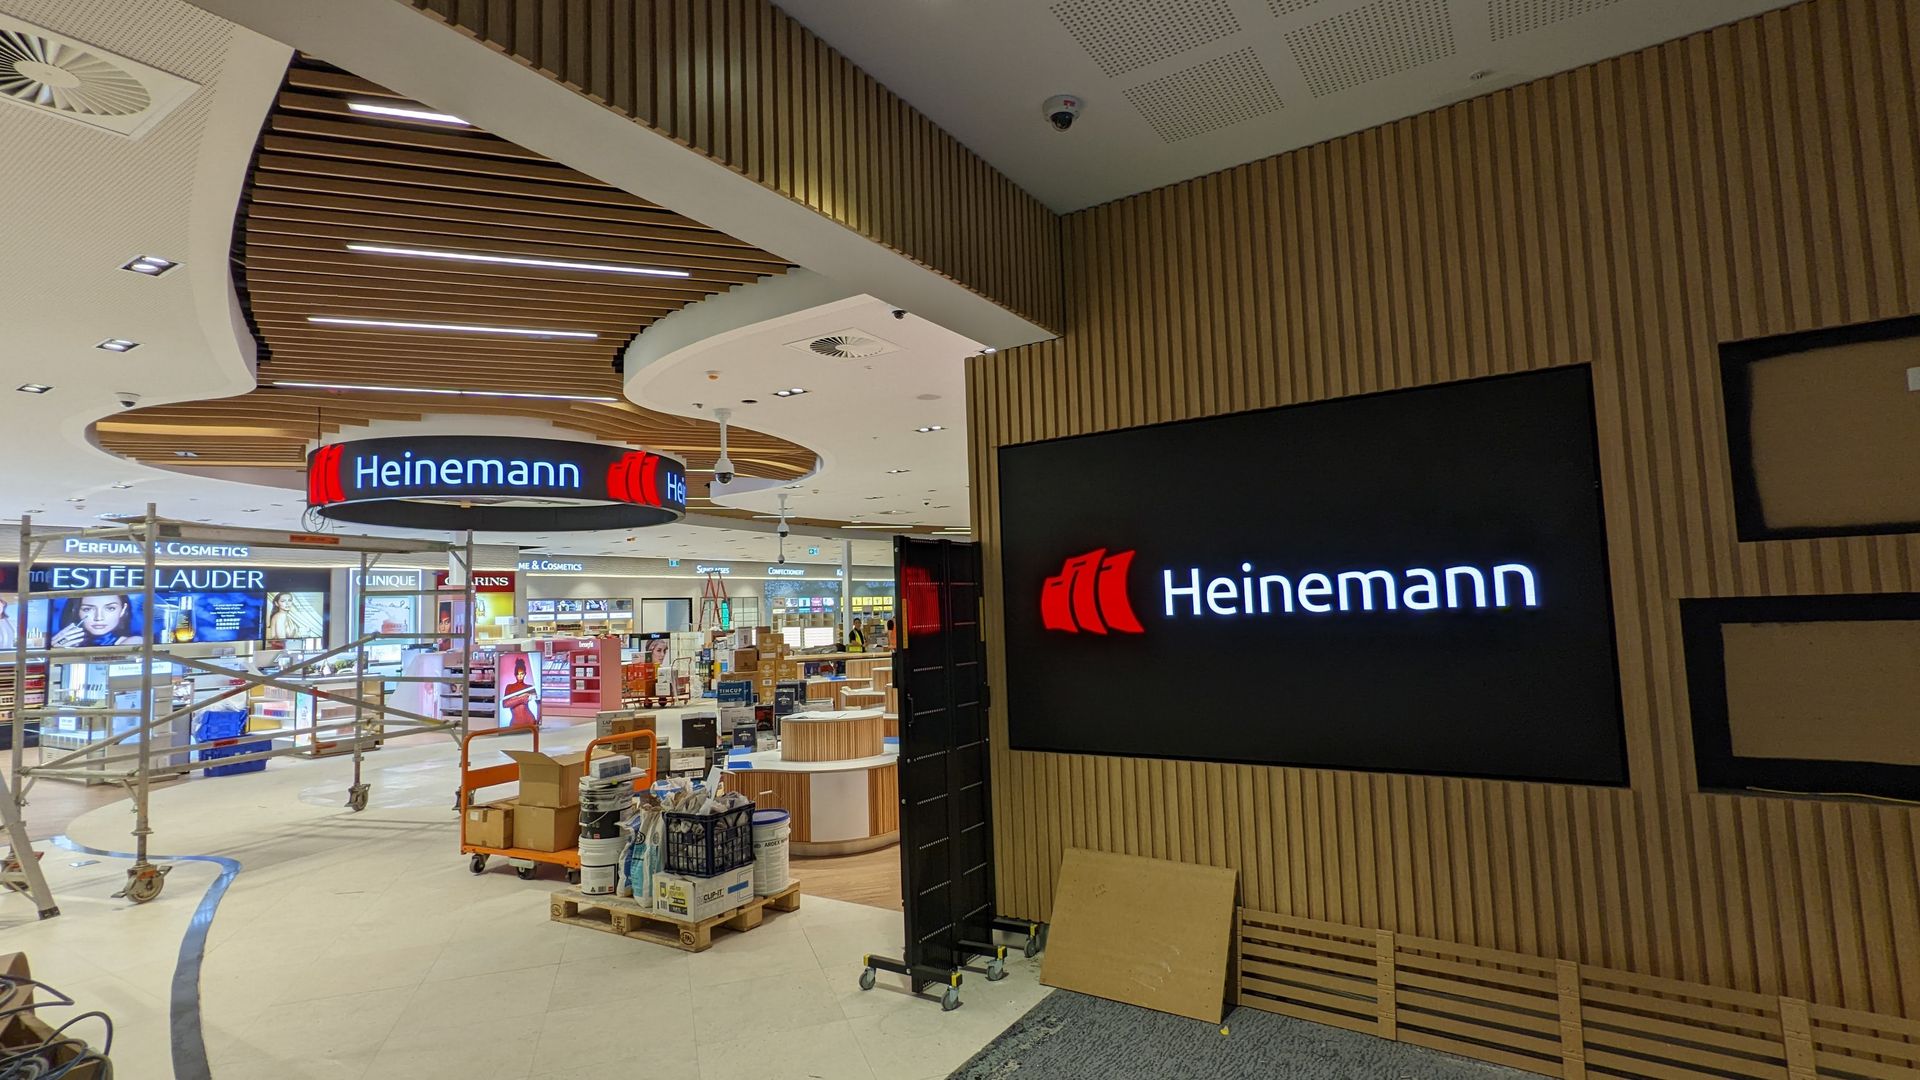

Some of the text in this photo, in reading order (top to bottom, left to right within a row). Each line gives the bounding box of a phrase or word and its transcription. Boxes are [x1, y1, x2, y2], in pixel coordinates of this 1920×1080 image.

[356, 452, 579, 489] Heinemann
[166, 542, 249, 557] COSMETICS
[532, 560, 540, 570] &
[541, 560, 583, 571] COSMETICS
[154, 569, 264, 589] LAUDER
[444, 576, 509, 587] CRINS
[1163, 562, 1537, 616] Heinemann
